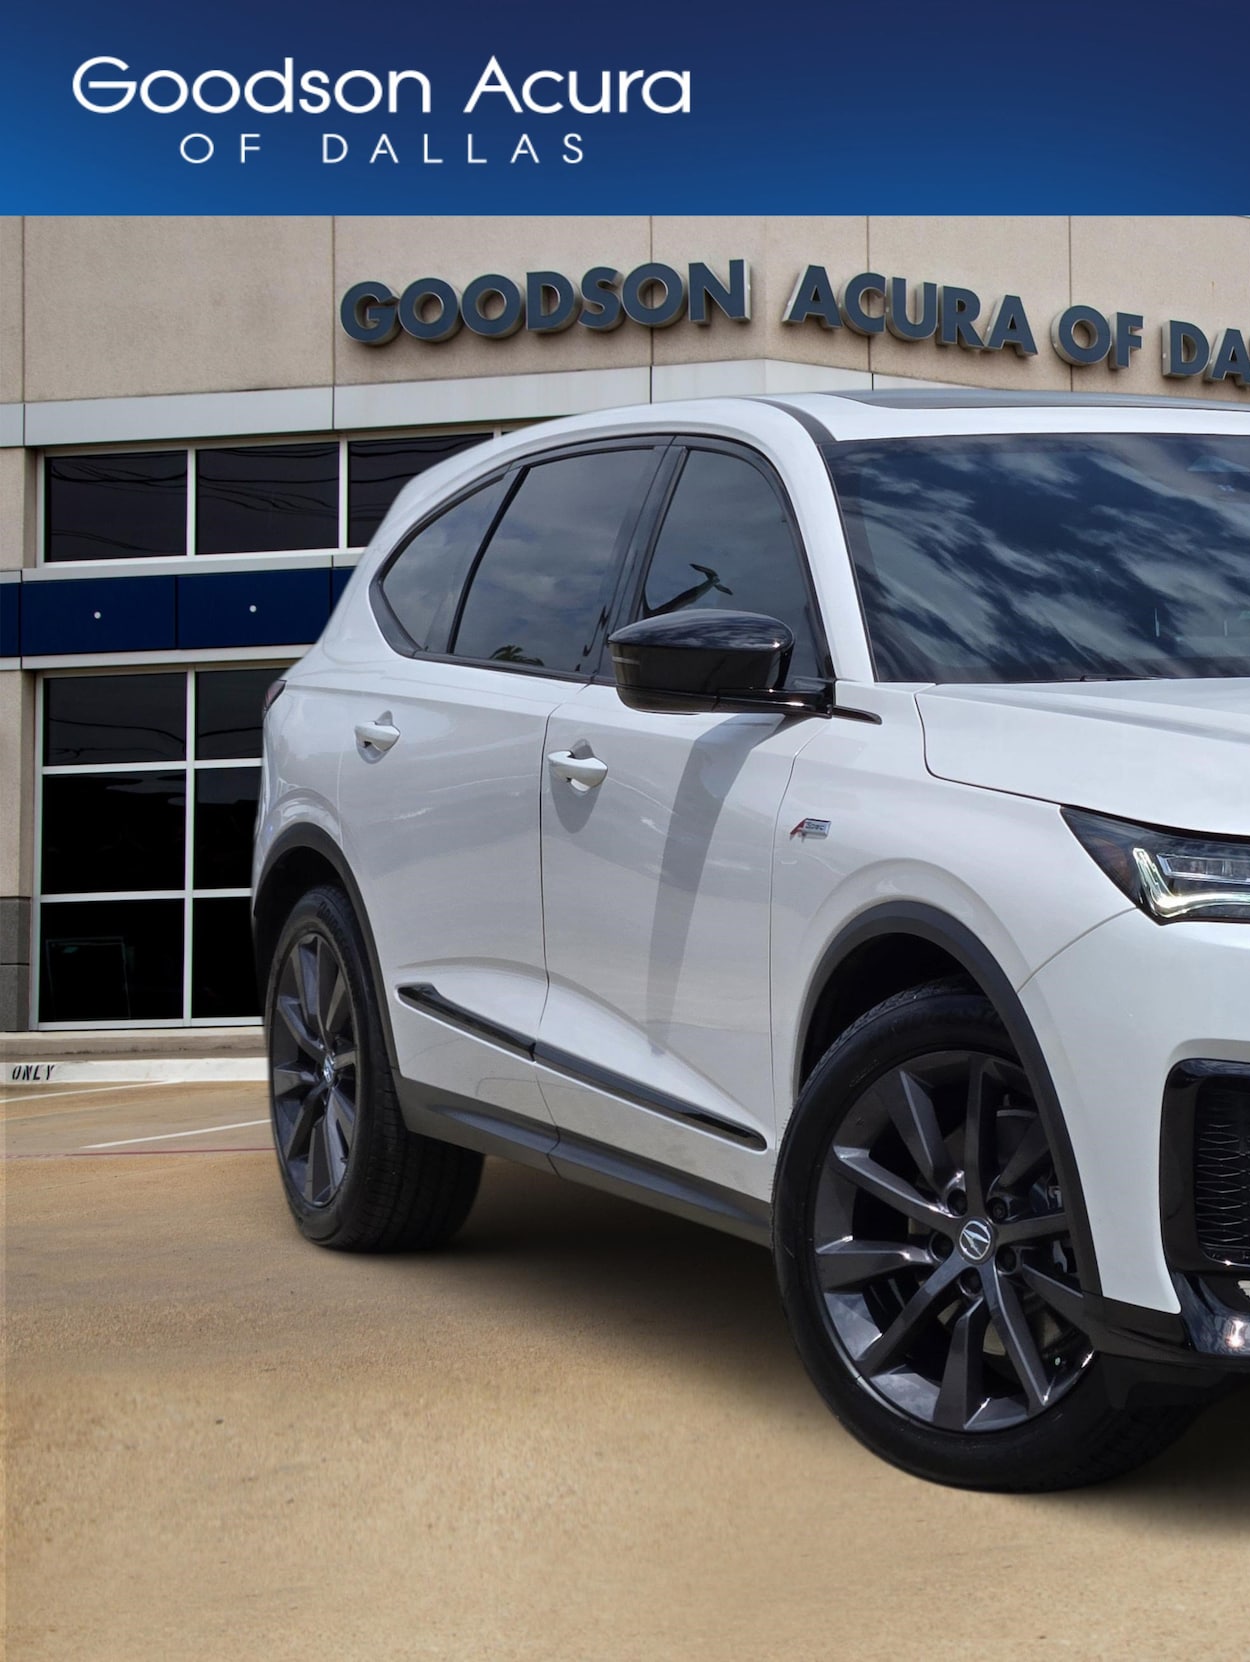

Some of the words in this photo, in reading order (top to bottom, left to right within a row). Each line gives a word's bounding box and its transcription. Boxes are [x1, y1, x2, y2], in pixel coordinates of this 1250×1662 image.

[340, 259, 752, 346] GOODSON
[782, 264, 1038, 356] ACURA
[1051, 304, 1143, 369] OF
[12, 1064, 55, 1081] ONLY
